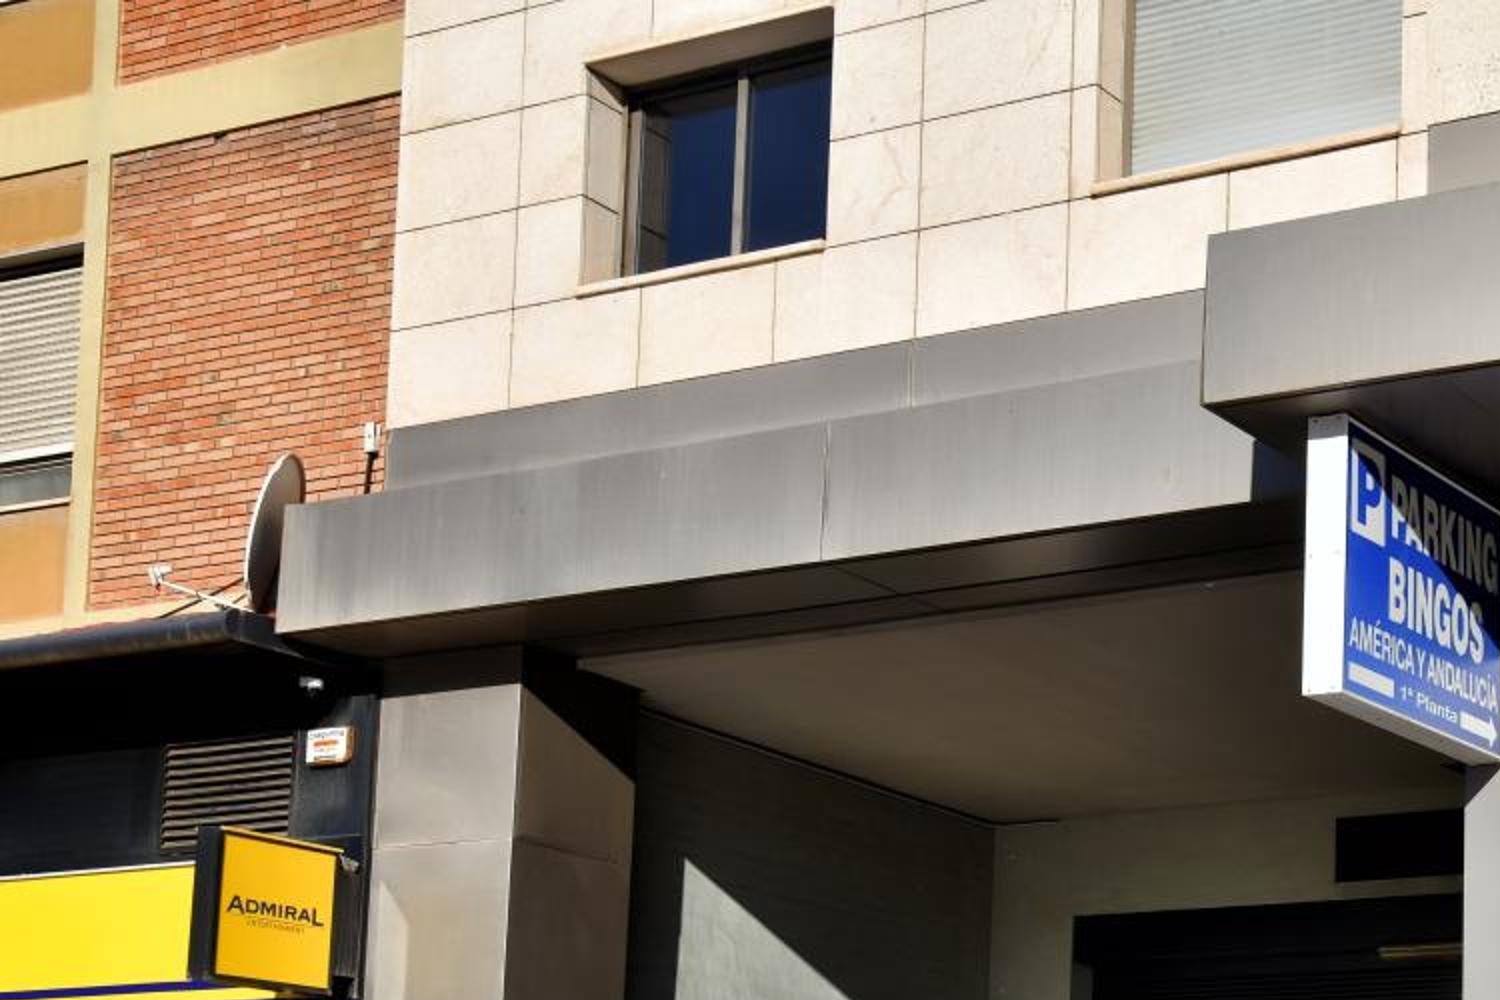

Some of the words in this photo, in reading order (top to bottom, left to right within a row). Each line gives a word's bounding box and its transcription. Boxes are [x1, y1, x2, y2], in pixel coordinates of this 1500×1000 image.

[1391, 474, 1499, 594] PARKING
[1388, 556, 1485, 664] BINGOS
[1349, 617, 1415, 676] AMÉRICA
[1416, 648, 1426, 679] Y
[1427, 654, 1499, 714] ANDALUCÍA
[1416, 692, 1458, 724] Planta
[226, 894, 325, 927] ADMIRAL
